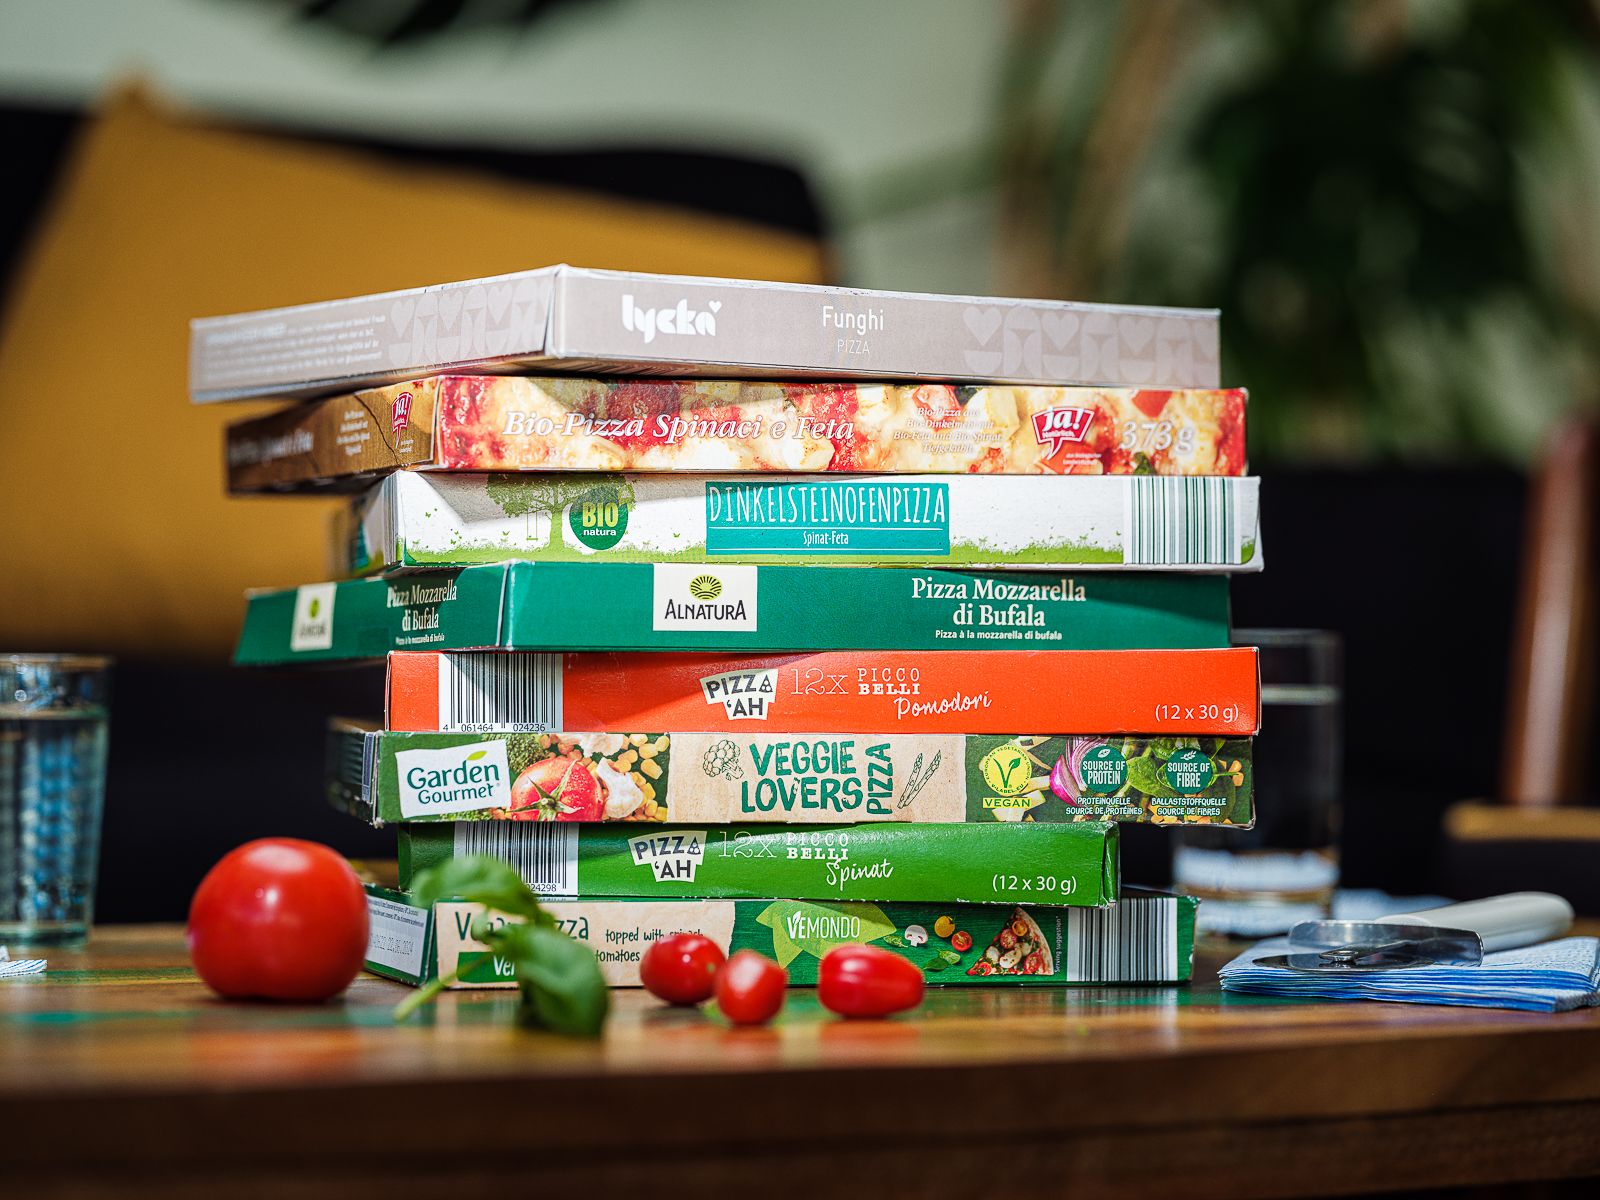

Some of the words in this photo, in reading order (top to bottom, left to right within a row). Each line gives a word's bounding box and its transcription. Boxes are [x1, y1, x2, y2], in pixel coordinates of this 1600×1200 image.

[822, 305, 885, 336] Funghi
[837, 339, 870, 354] PIZZA
[918, 407, 961, 418] Bio-Pizza
[1041, 405, 1085, 432] ja!
[502, 410, 645, 438] Bio-Pizza
[652, 413, 763, 444] Spinaci
[770, 423, 785, 439] e
[792, 417, 855, 440] Feta
[894, 431, 930, 441] Bio-Feta
[933, 432, 952, 441] und
[1119, 420, 1173, 450] 373
[1175, 427, 1195, 454] g
[582, 501, 618, 528] BIO
[709, 485, 946, 524] DINKELSTEINOFENPIZZA
[803, 531, 849, 547] Spinat-Feta
[387, 585, 409, 608] Pizza
[411, 579, 458, 605] Mozzarella
[911, 576, 968, 600] Pizza
[972, 578, 1087, 602] Mozzarella
[402, 609, 411, 632] di
[412, 607, 440, 631] Bufala
[664, 598, 747, 621] ALNATURA
[952, 602, 974, 626] di
[978, 603, 1046, 627] Bufala
[935, 629, 958, 639] Pizza
[967, 630, 975, 639] la
[977, 630, 1023, 640] mozzarella
[1025, 630, 1033, 640] di
[1035, 630, 1063, 641] bufala
[705, 672, 774, 699] PIZZA
[790, 667, 849, 695] 12x
[857, 667, 921, 682] PICCO
[858, 683, 921, 696] BELLI
[893, 691, 992, 720] Pomodori
[1155, 703, 1180, 722] (12
[1185, 707, 1195, 720] x
[1198, 704, 1219, 720] 30
[1222, 703, 1239, 723] g)
[460, 723, 494, 732] 061464
[512, 723, 546, 732] 024236
[749, 740, 856, 776] VEGGIE
[1082, 760, 1114, 771] SOURCE
[1115, 760, 1126, 771] OF
[1167, 762, 1198, 772] SOURCE
[1199, 763, 1210, 773] OF
[407, 758, 500, 790] Garden
[865, 742, 893, 815] PIZZA
[1087, 770, 1121, 785] PROTEIN
[1176, 772, 1201, 788] FIBRE
[417, 783, 494, 805] Gourmet
[741, 776, 864, 813] LOVERS
[984, 798, 1031, 807] VEGAN
[1077, 797, 1131, 807] PROTEINQUELLE
[1151, 797, 1227, 807] BALLASTSTOFFQUELLE
[1065, 807, 1094, 816] SOURCE
[1095, 806, 1104, 815] DE
[1157, 807, 1185, 816] SOURCE
[1186, 807, 1196, 816] DE
[1197, 807, 1221, 817] FIBRES
[634, 835, 702, 861] PIZZA
[718, 831, 777, 858] 12x
[786, 832, 849, 847] PICCO
[786, 847, 849, 860] BELLI
[826, 858, 894, 892] Spinat
[992, 874, 1018, 892] (12
[1022, 878, 1032, 891] x
[1036, 875, 1056, 891] 30
[1060, 875, 1077, 895] g)
[787, 910, 861, 939] VEMONDO
[605, 927, 639, 945] topped
[595, 949, 641, 963] tomatoes
